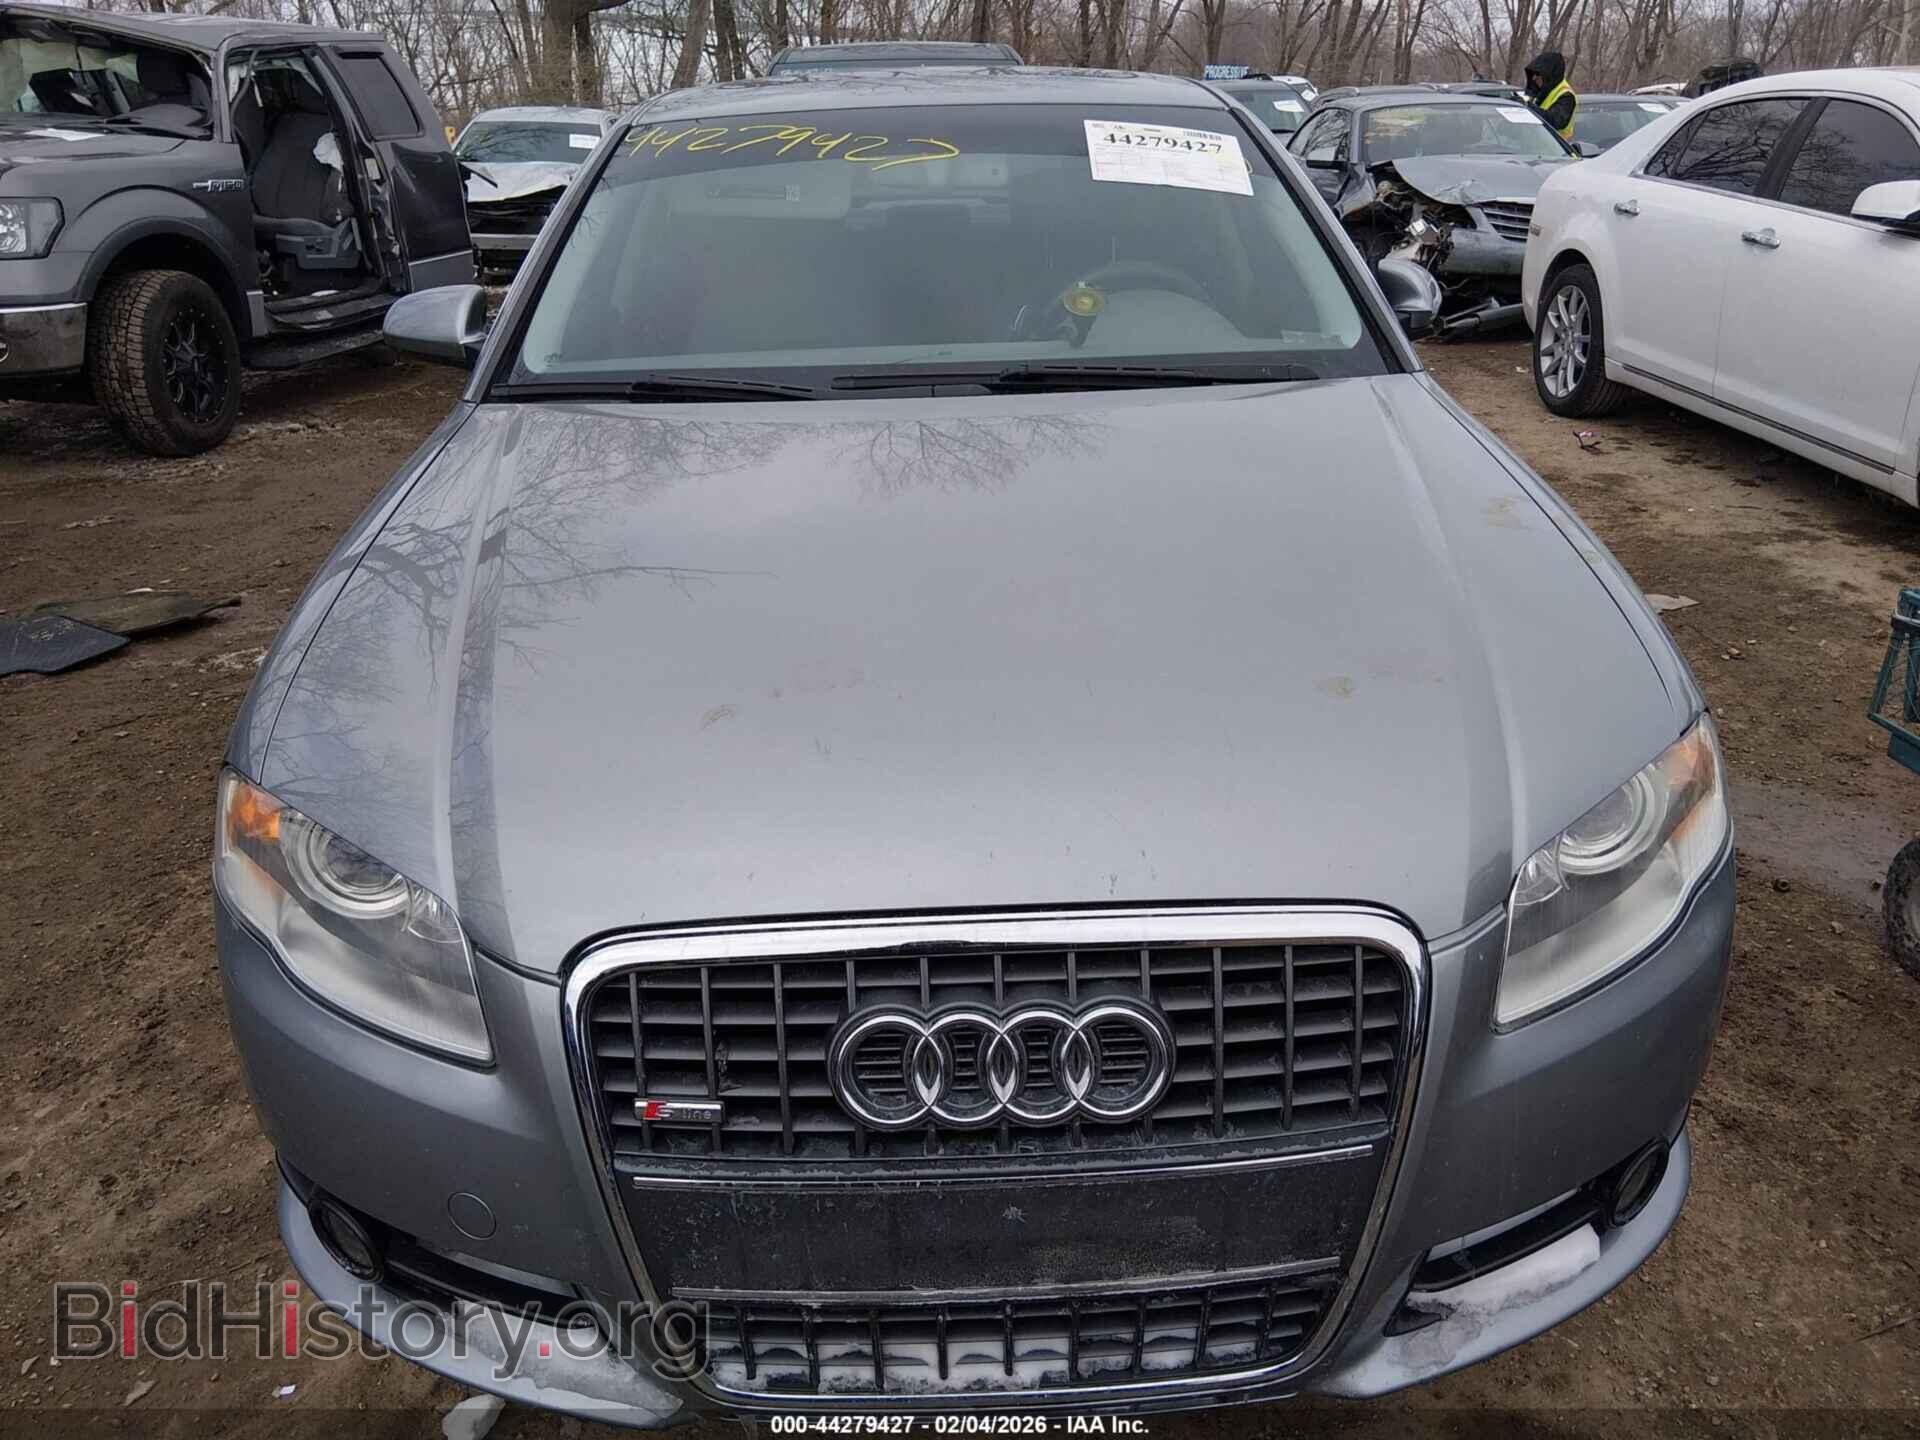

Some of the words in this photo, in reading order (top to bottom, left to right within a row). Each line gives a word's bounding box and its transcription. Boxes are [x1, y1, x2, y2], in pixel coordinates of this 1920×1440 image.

[625, 124, 961, 171] 44279427
[1103, 132, 1222, 154] 44279427
[682, 1108, 712, 1120] line
